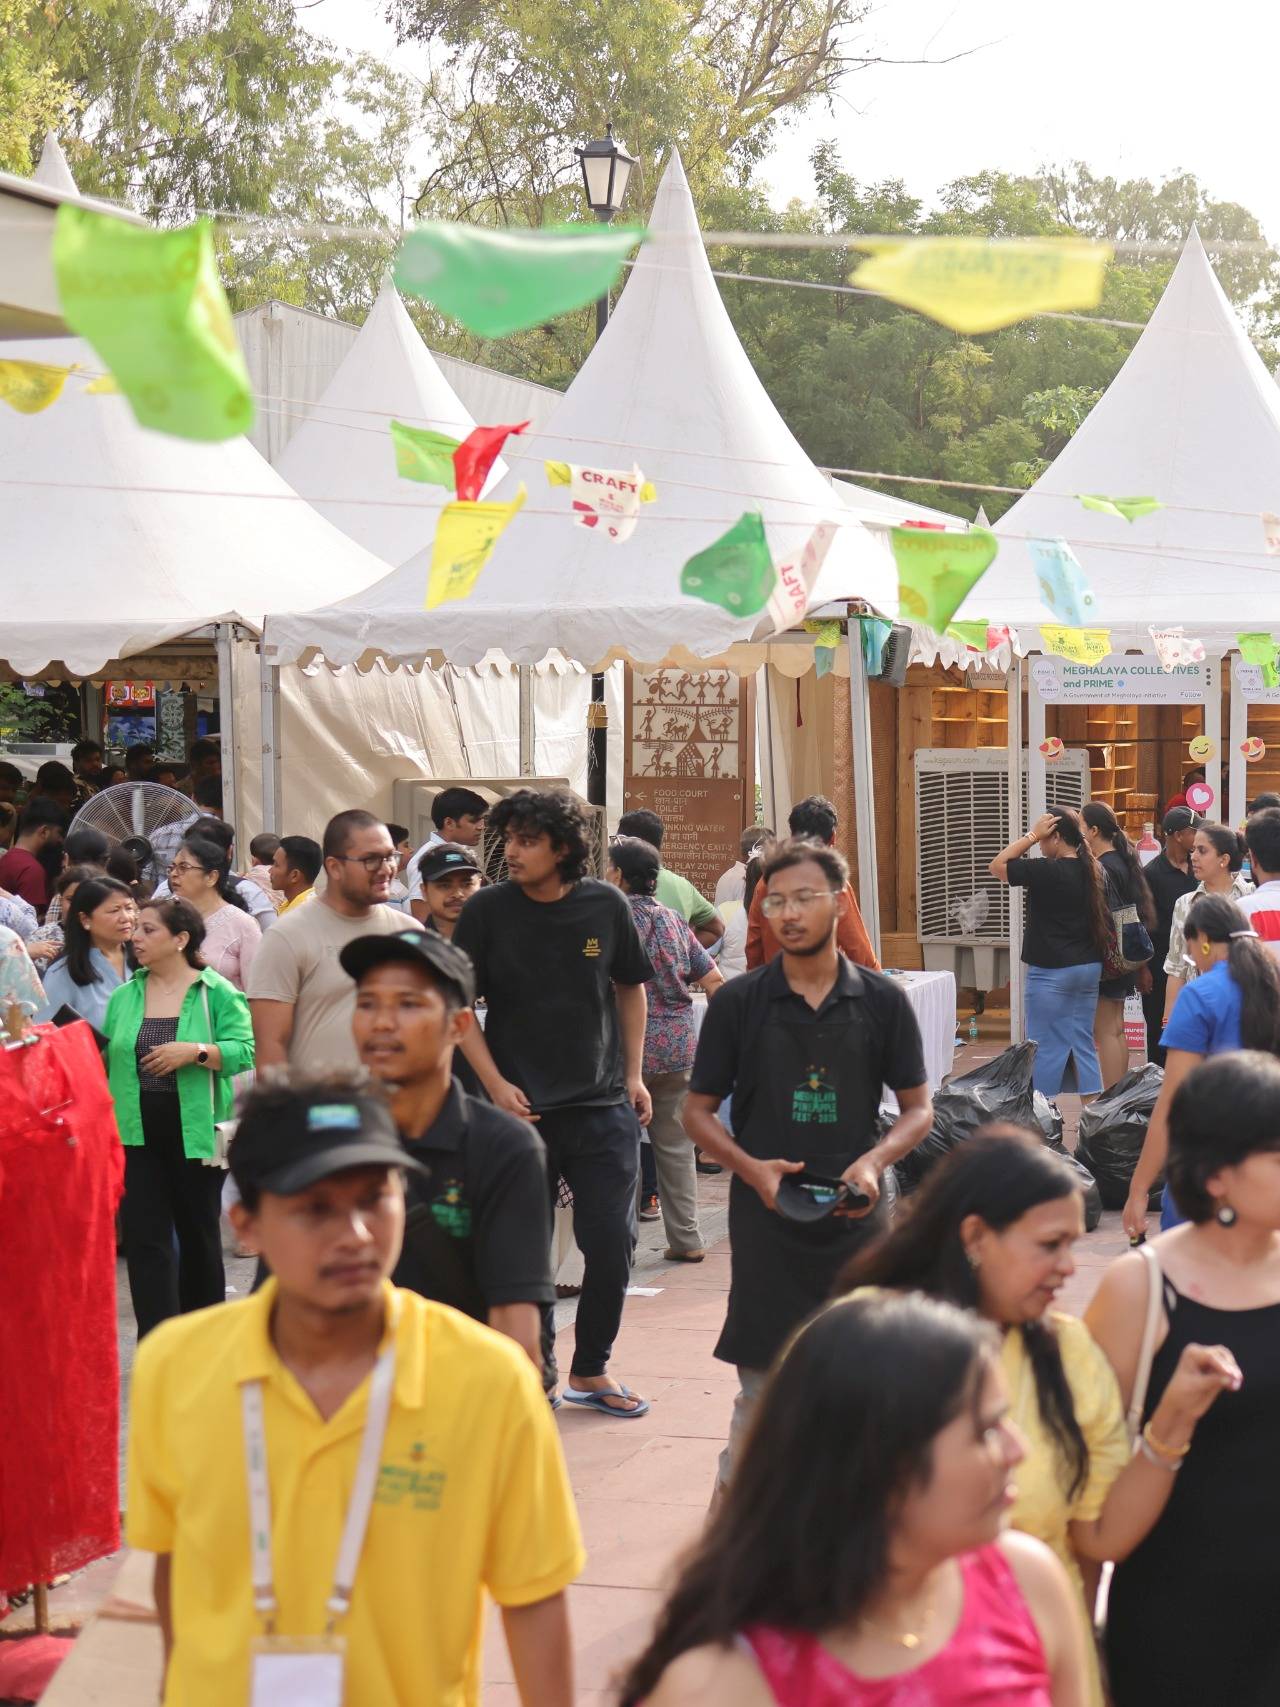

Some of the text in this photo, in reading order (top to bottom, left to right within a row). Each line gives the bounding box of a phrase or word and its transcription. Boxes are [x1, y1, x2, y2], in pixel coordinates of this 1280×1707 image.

[581, 471, 638, 493] CRAFT
[1063, 666, 1129, 675] MEGHALAYA
[1063, 680, 1114, 688] and PRIME
[654, 789, 709, 798] FOOD COURT
[655, 804, 684, 813] TOILET
[695, 824, 726, 832] WATER
[674, 861, 696, 870] PLAY
[697, 862, 720, 871] ZONE
